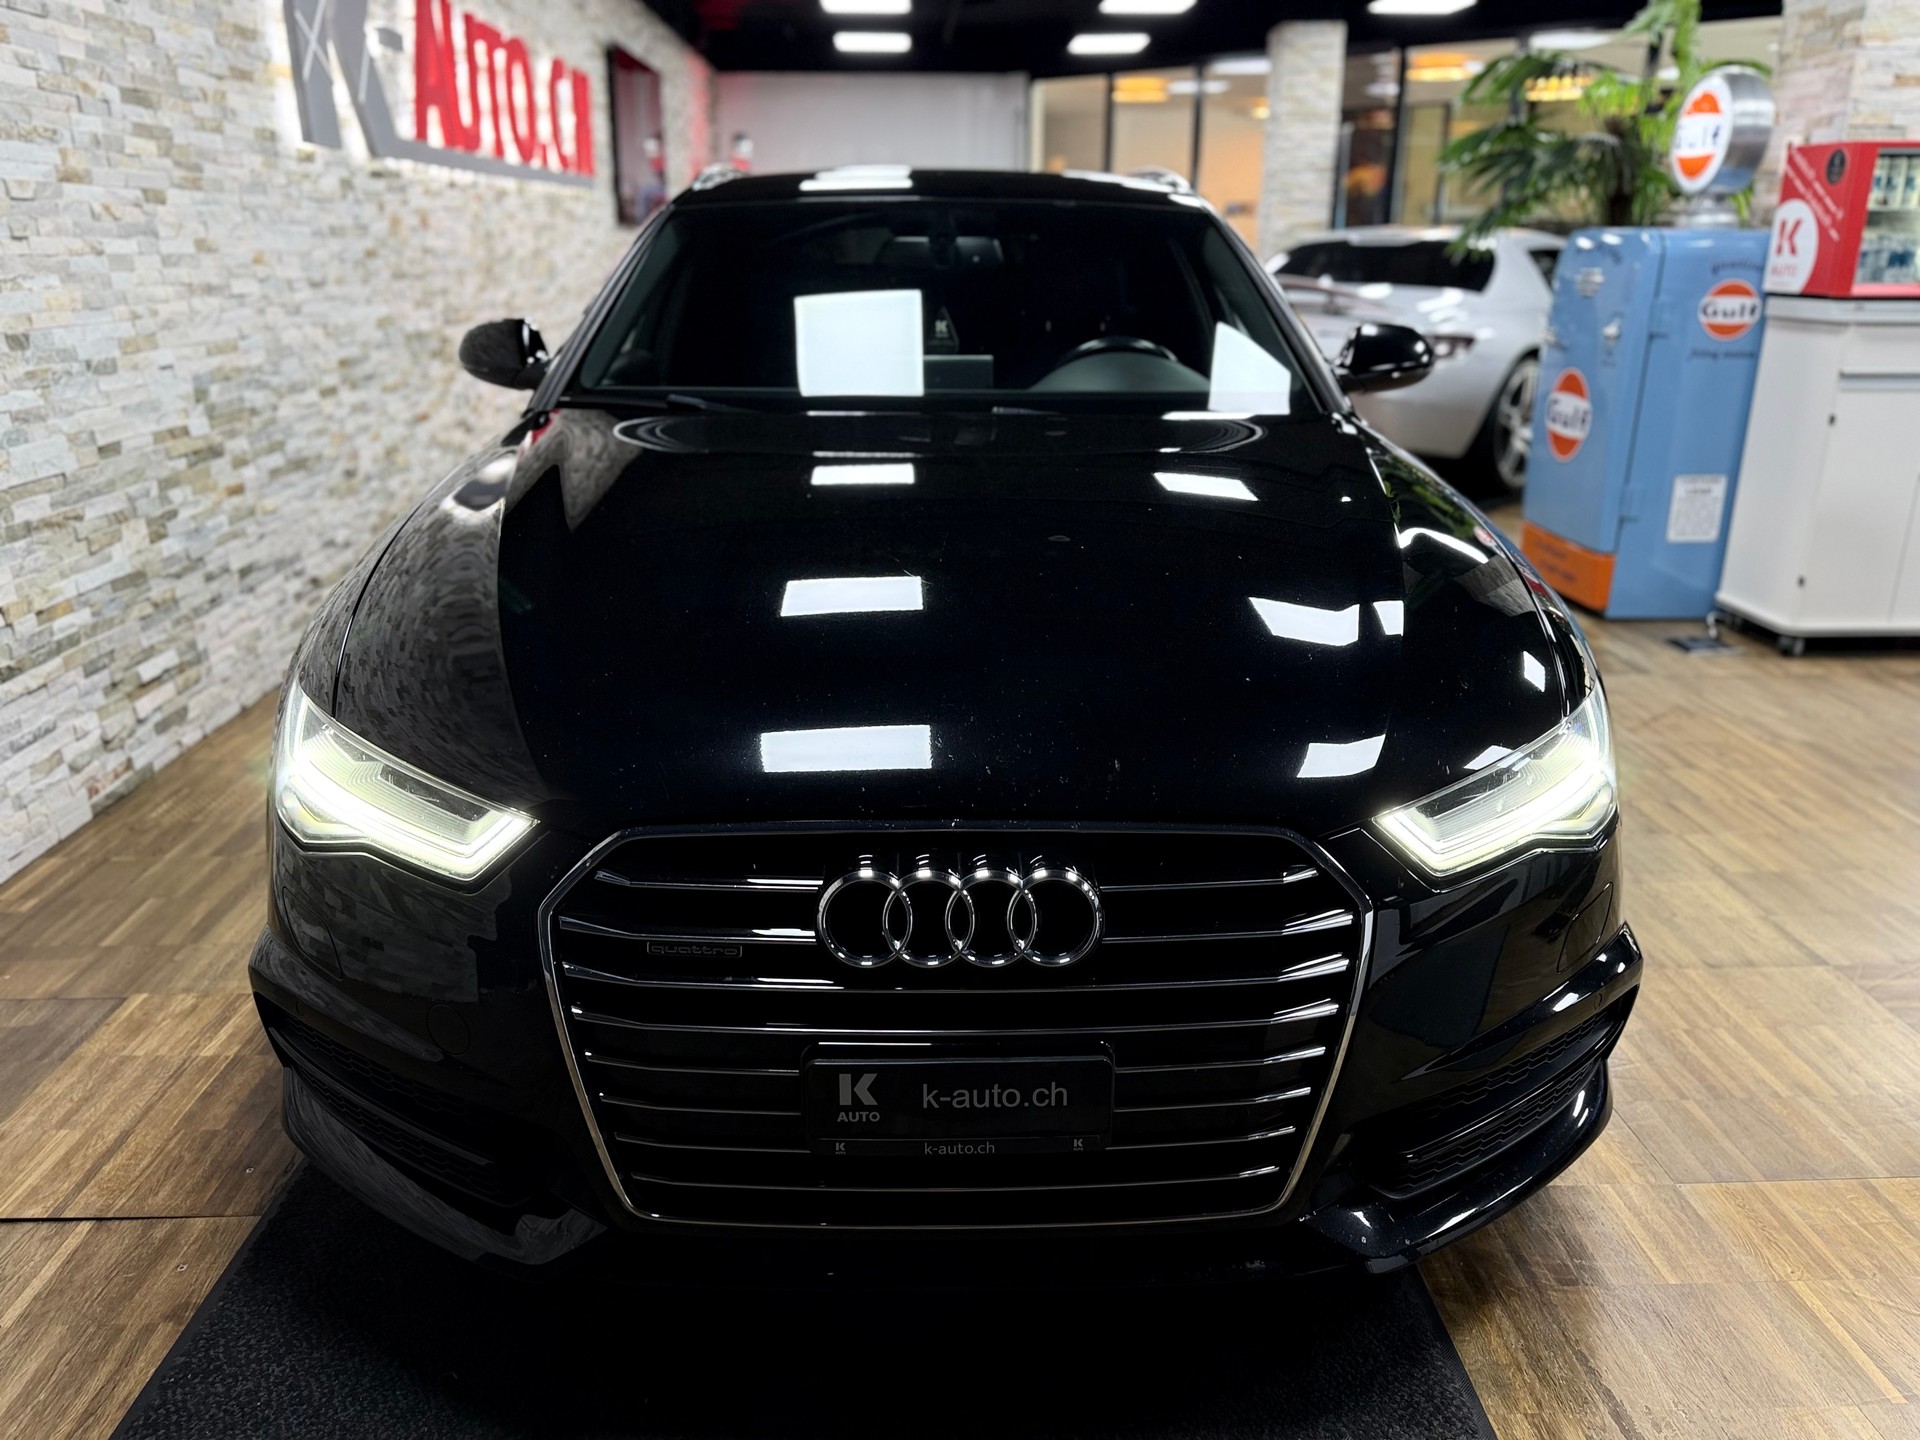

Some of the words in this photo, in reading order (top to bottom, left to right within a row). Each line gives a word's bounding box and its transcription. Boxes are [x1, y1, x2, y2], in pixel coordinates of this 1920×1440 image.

[1702, 300, 1757, 318] Gulf
[1547, 398, 1591, 431] Gulf
[651, 945, 738, 956] quattro
[839, 1073, 878, 1106] K
[922, 1081, 1068, 1109] k-auto.ch
[837, 1111, 880, 1123] AUTO
[924, 1141, 995, 1155] k-auto.ch
